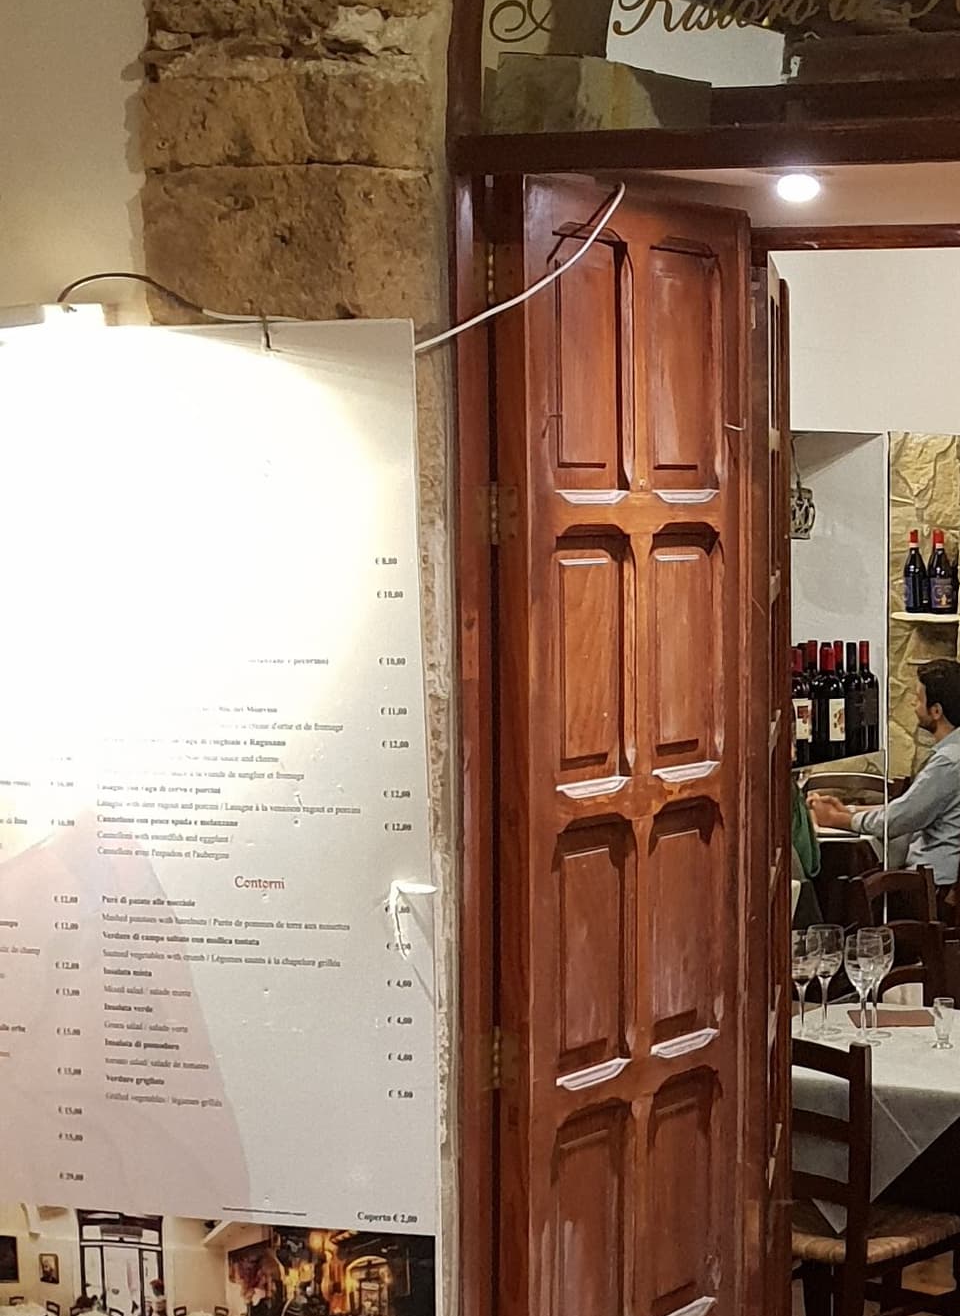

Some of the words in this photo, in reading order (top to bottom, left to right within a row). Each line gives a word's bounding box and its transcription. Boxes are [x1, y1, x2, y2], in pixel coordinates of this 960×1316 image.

[234, 875, 286, 890] Contorni
[357, 1211, 391, 1223] Coperto
[400, 1213, 418, 1223] 2,00
